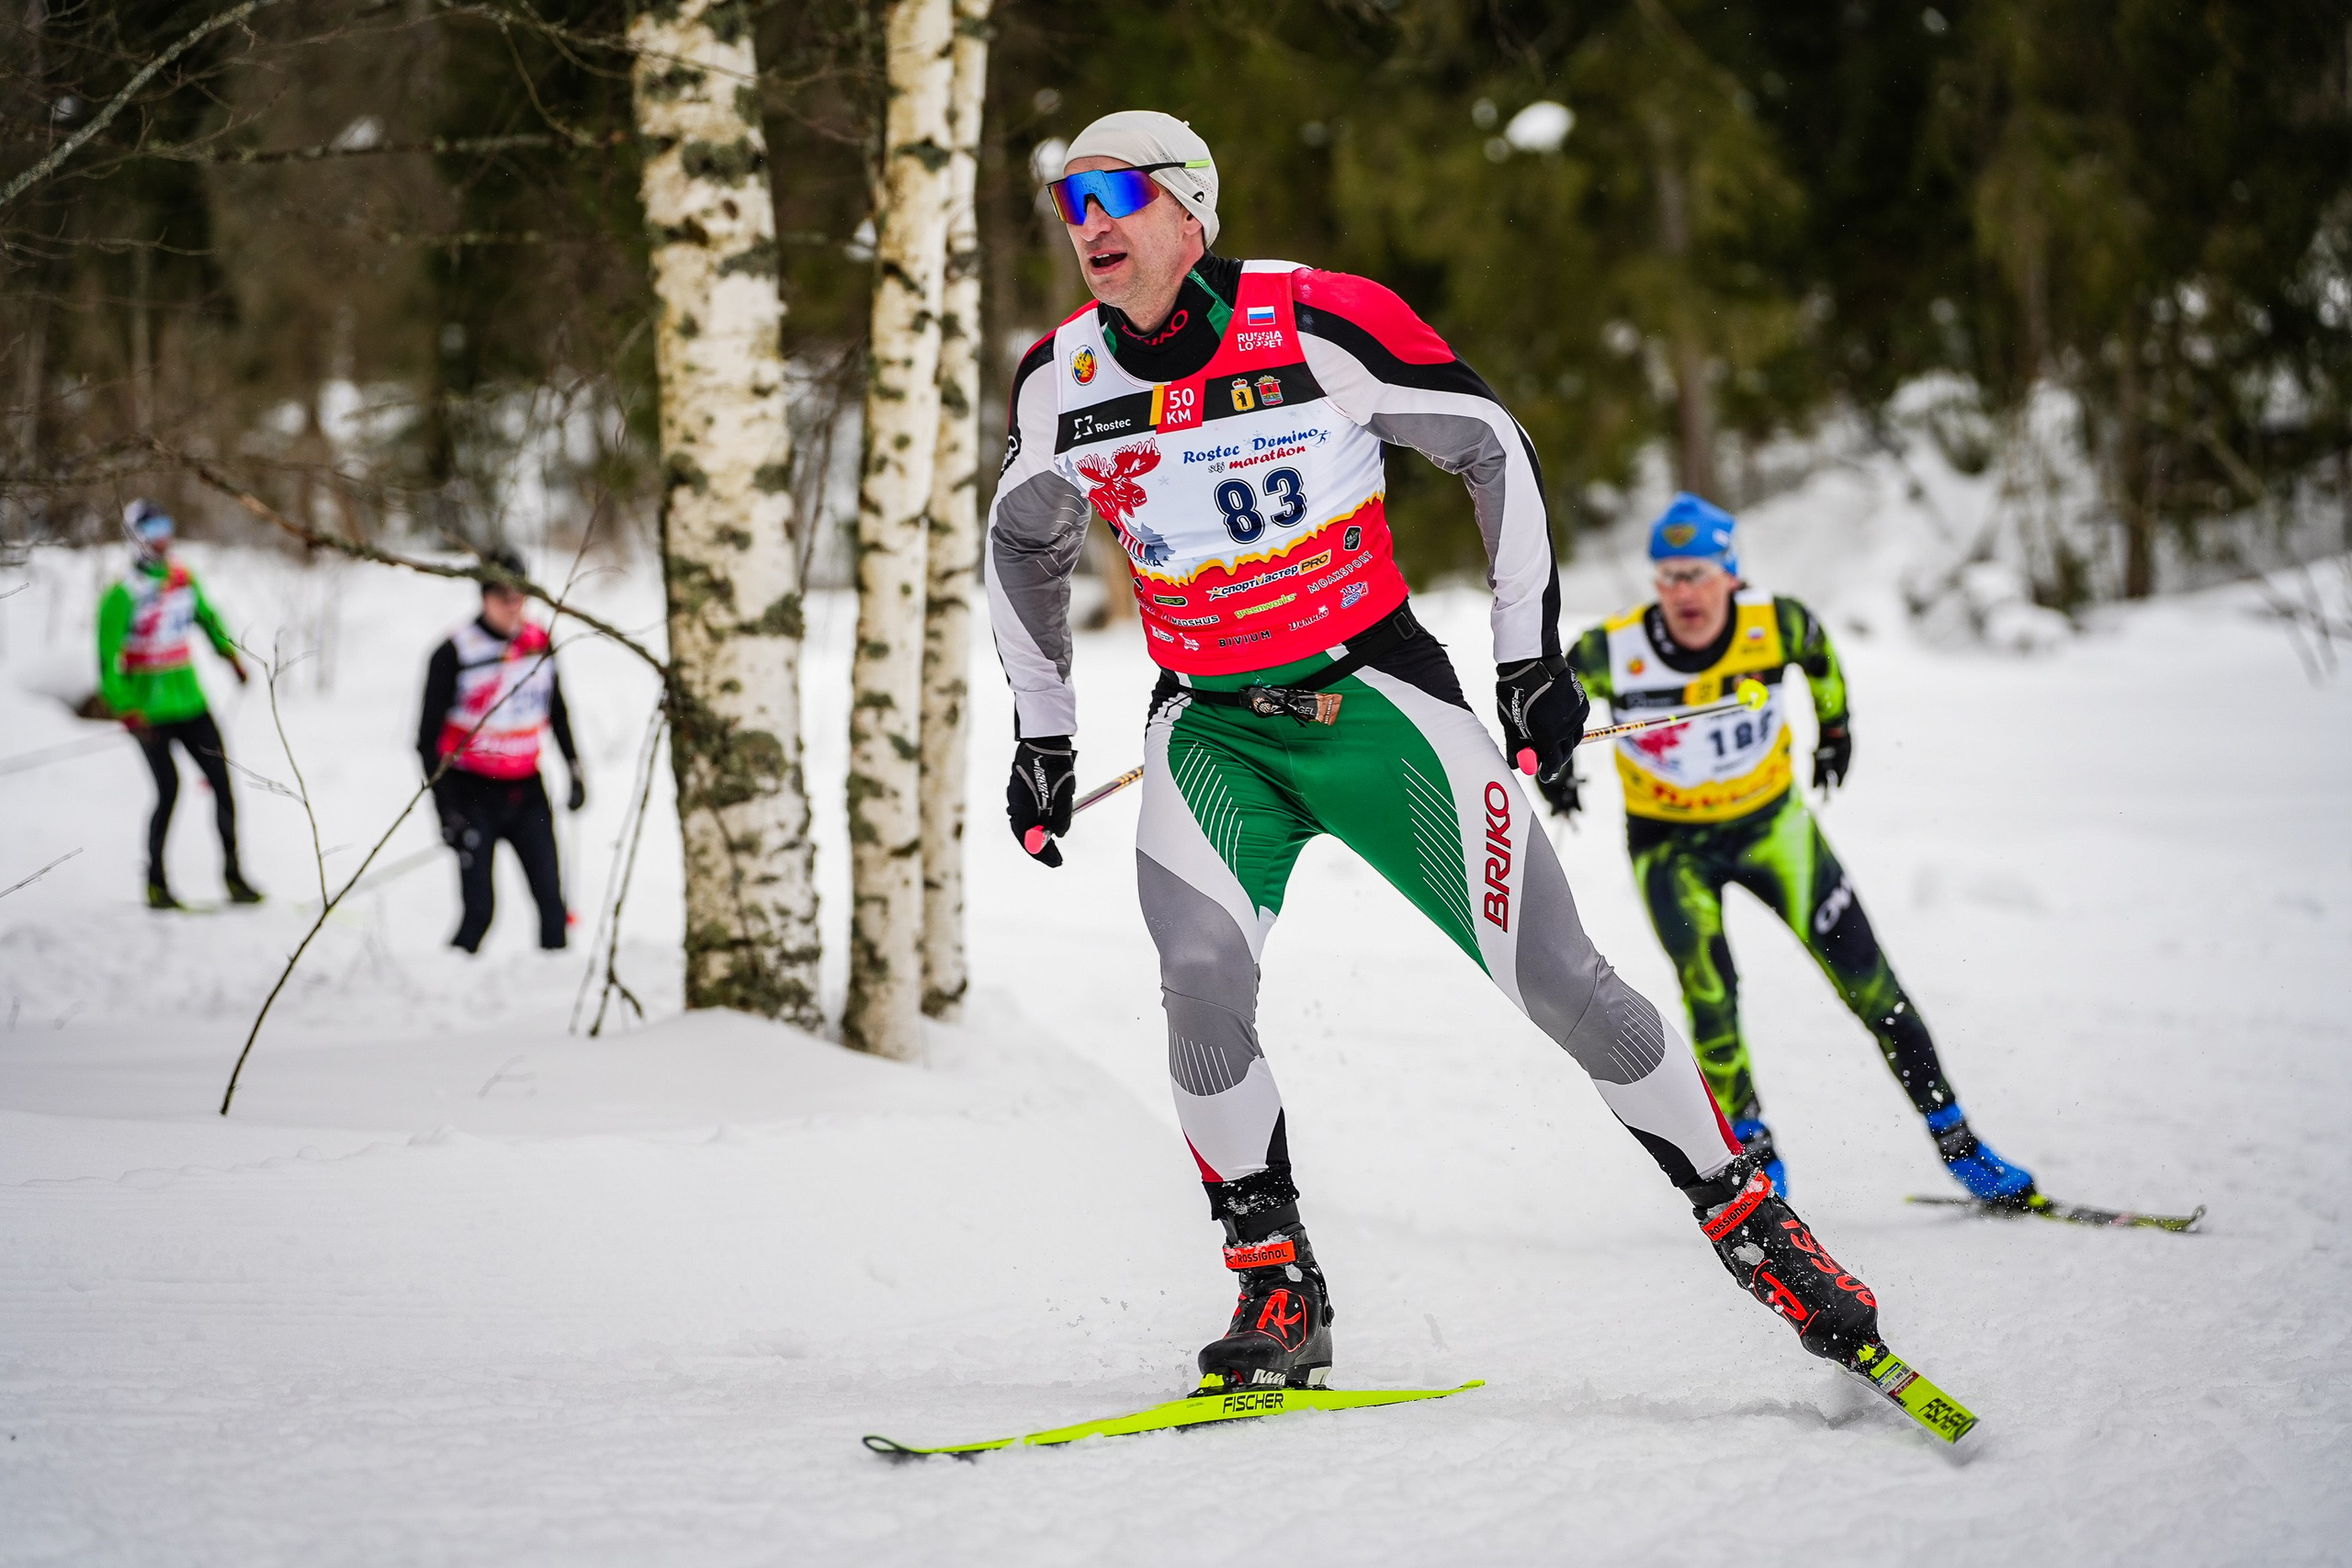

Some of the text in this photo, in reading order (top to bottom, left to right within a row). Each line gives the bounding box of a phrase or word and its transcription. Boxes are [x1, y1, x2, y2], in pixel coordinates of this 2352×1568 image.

[1237, 331, 1283, 343] RUSSIA
[1169, 388, 1195, 410] 50
[1095, 418, 1132, 433] Rostec
[1166, 409, 1192, 425] KM
[1182, 428, 1318, 464] Rostec Demino
[1228, 446, 1306, 469] marathon
[1214, 467, 1307, 545] 83
[1301, 553, 1329, 572] PRO
[1307, 550, 1374, 594] MOAXSPORT
[1234, 592, 1297, 619] greenworks
[1170, 615, 1221, 627] MADSHUS
[1218, 629, 1272, 648] BIVIUM
[1297, 705, 1316, 716] GEL
[1484, 781, 1512, 933] BRIKO
[1707, 1201, 1752, 1238] ROSSIGNOL
[1238, 1248, 1288, 1264] ROSSIGNOL
[1223, 1393, 1284, 1414] FISCHER
[1917, 1397, 1968, 1435] FISCHER
